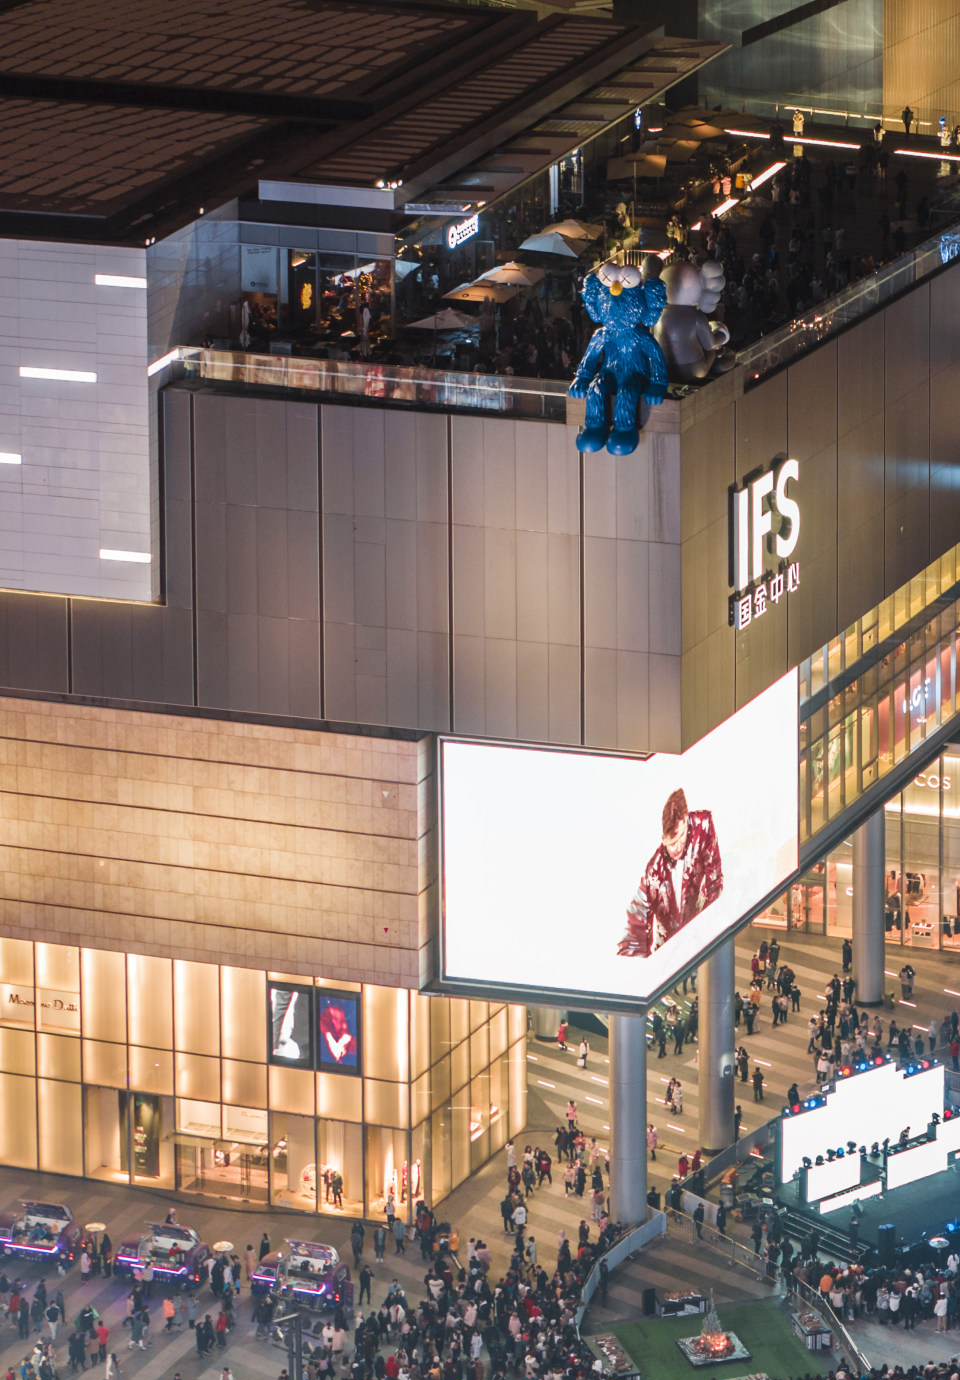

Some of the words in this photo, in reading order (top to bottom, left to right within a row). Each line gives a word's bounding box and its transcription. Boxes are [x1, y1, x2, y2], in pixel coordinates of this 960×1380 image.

[738, 459, 801, 591] IFS
[738, 562, 801, 631] 国金中心
[914, 773, 952, 790] COS
